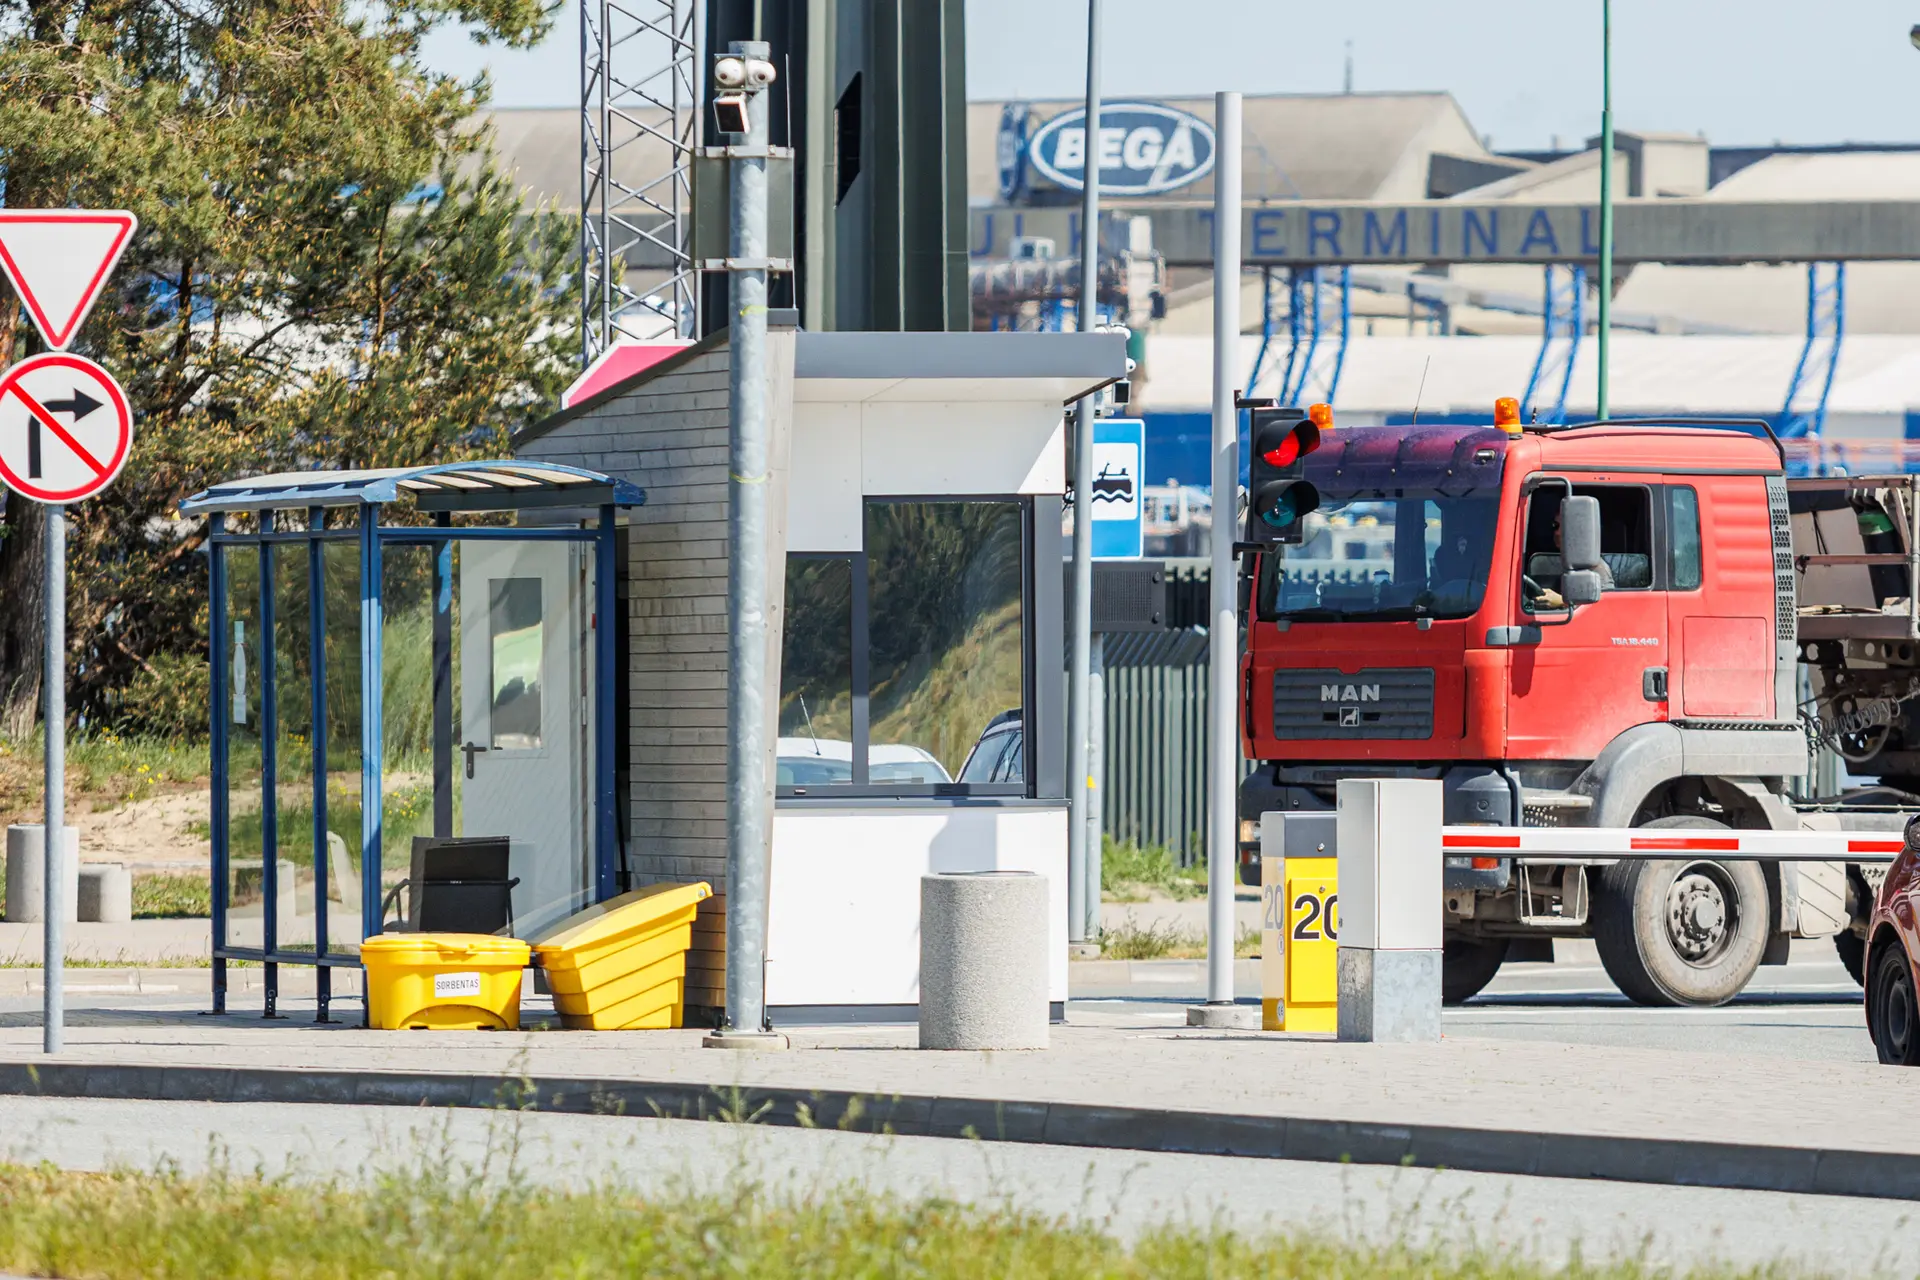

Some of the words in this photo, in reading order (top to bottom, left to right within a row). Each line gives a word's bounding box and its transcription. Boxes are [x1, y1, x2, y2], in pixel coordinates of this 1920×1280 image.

[1053, 116, 1196, 184] BEGA
[1321, 684, 1380, 701] MAN
[1264, 884, 1284, 930] 20
[436, 979, 479, 990] SORBENTAS
